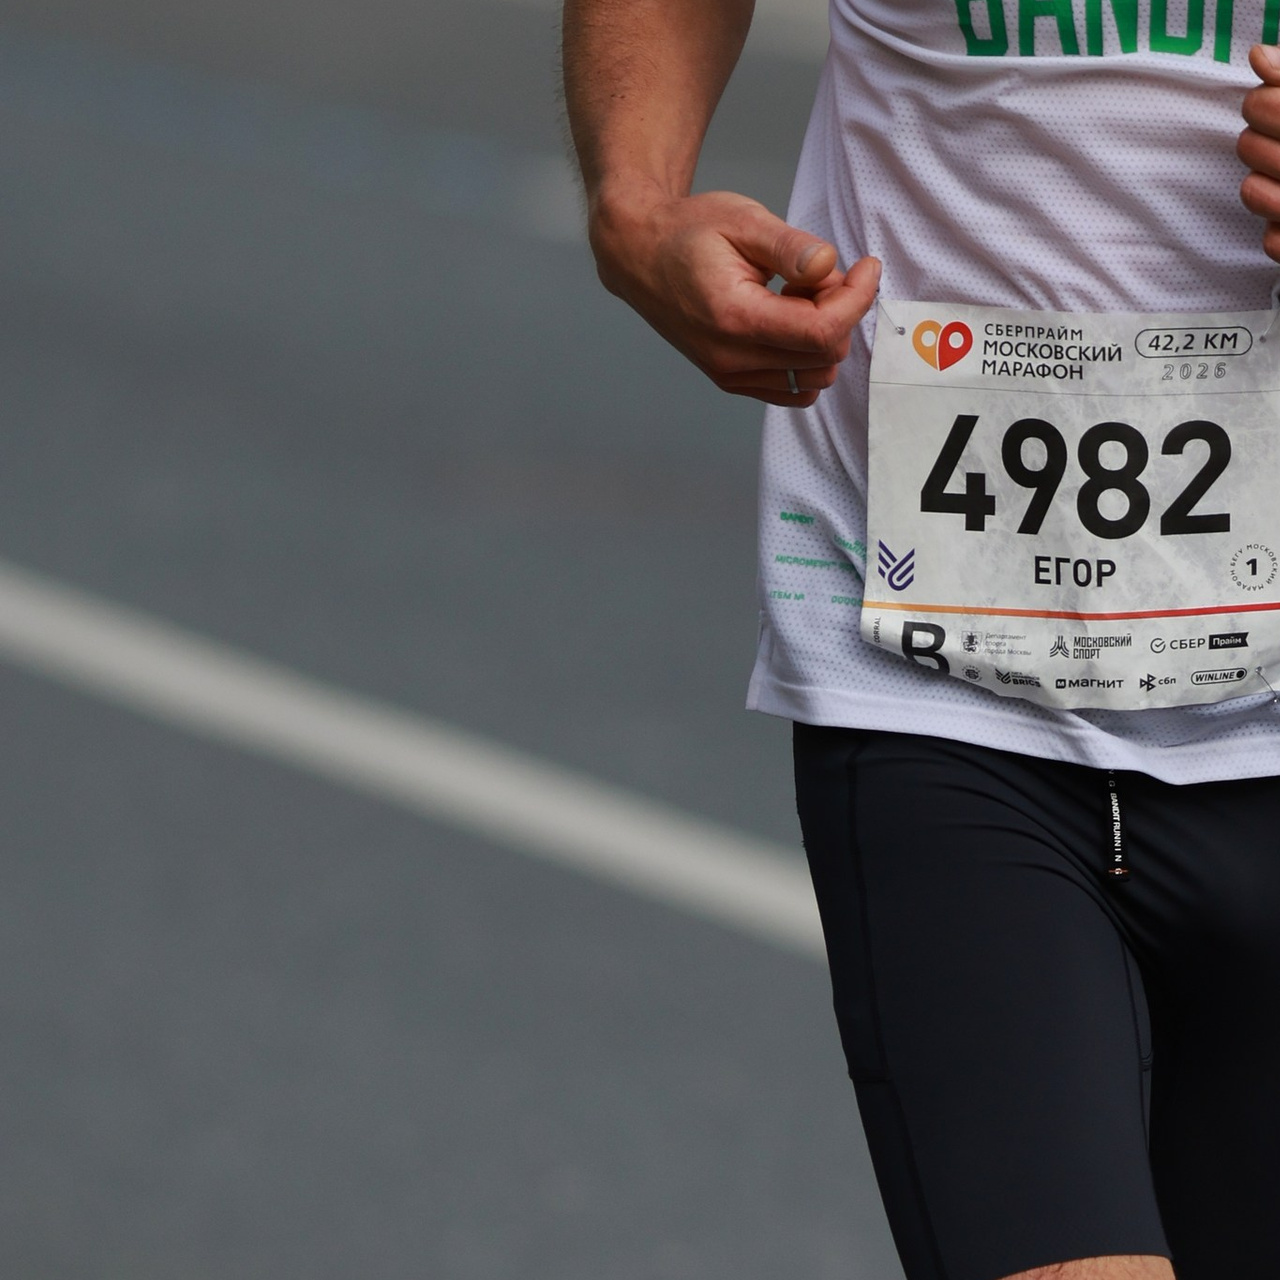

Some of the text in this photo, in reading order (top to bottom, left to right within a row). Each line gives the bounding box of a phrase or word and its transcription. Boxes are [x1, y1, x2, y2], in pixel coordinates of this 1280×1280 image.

[984, 323, 1083, 341] СБЕРПРАЙМ
[983, 340, 1122, 362] МОСКОВСКИЙ
[1148, 332, 1238, 353] 42,2 КМ
[981, 359, 1083, 380] МАРАФОН
[1161, 361, 1227, 381] 2026
[920, 414, 1232, 540] 4982
[1034, 555, 1117, 588] ЕГОР
[1245, 557, 1257, 576] 1
[901, 620, 951, 674] B
[1073, 632, 1132, 648] МОСКОВСКИЙ
[1169, 636, 1242, 650] СБЕР Прайм
[1073, 647, 1101, 660] СПОРТ
[1012, 678, 1042, 688] BRICS
[1068, 678, 1124, 689] магнит
[1158, 676, 1177, 686] сбп
[1195, 671, 1235, 682] WINLINE
[1110, 793, 1121, 821] BANDIT
[1112, 822, 1123, 875] RUNNING
